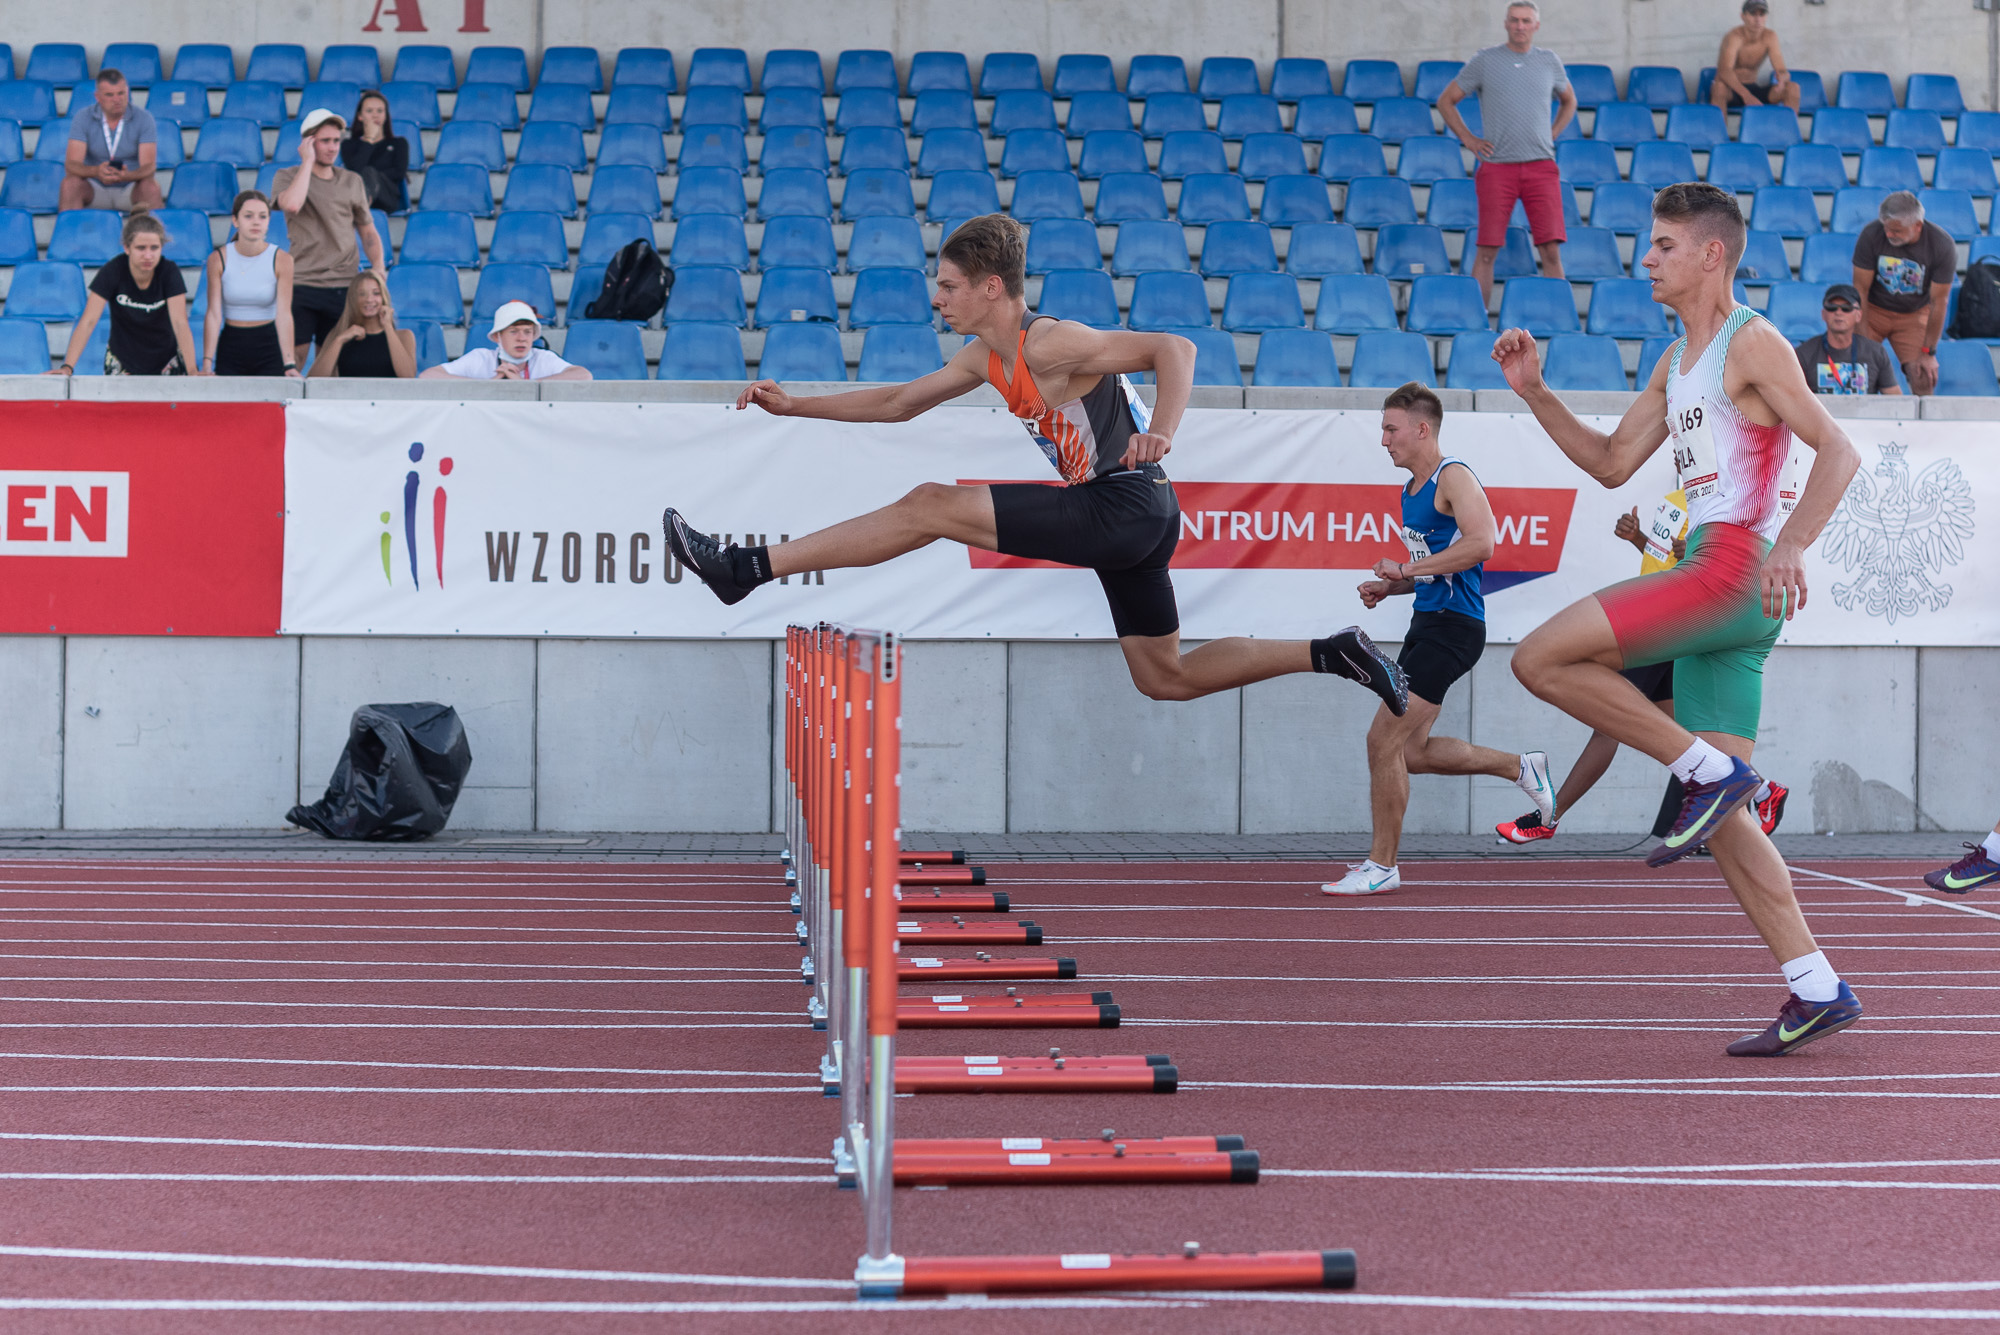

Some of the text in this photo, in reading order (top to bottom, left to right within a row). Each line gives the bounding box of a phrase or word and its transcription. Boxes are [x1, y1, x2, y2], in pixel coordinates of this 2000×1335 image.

[1679, 406, 1703, 433] 169
[1701, 484, 1714, 497] 2021
[0, 485, 107, 542] EN
[1178, 510, 1549, 546] NTRUM HANWE
